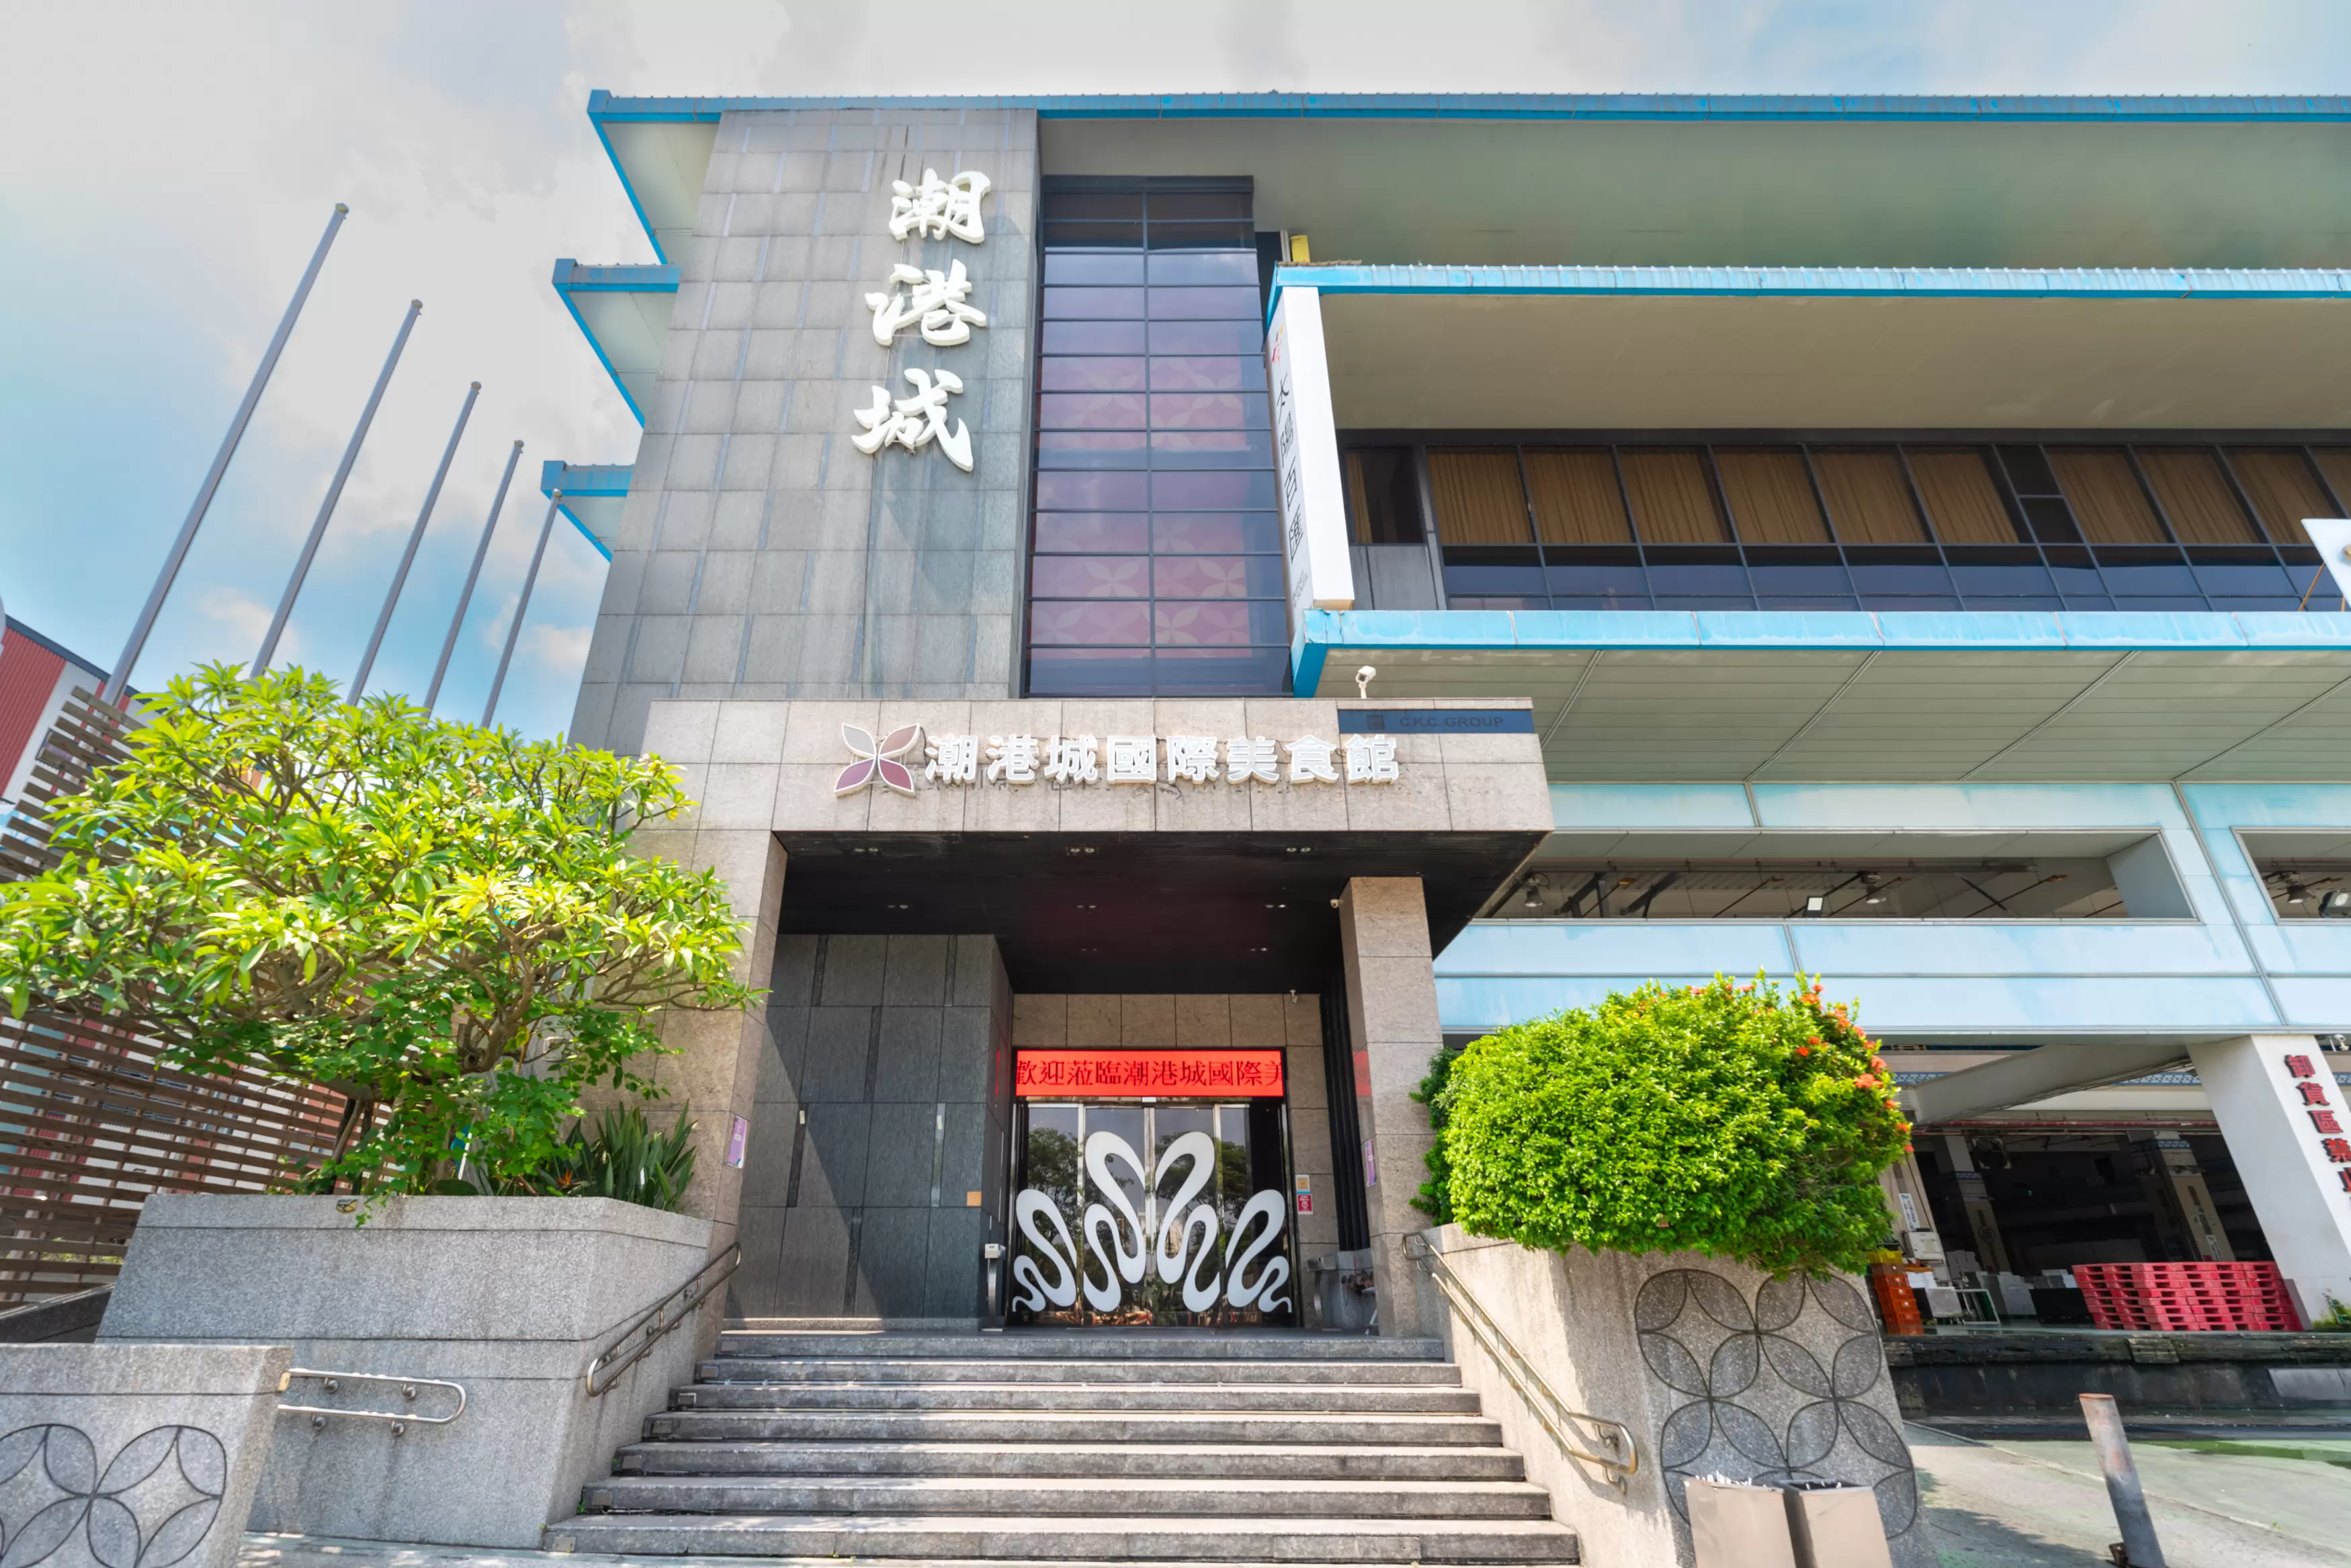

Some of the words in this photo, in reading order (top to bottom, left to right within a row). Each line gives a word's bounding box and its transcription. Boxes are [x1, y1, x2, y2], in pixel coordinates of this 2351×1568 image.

[851, 168, 990, 473] 潮港城
[1277, 372, 1303, 564] 太陽百匯
[925, 733, 1400, 785] 潮港城國際美食館
[1445, 717, 1504, 728] GROUP
[2284, 1054, 2351, 1192] 卸貨區禁
